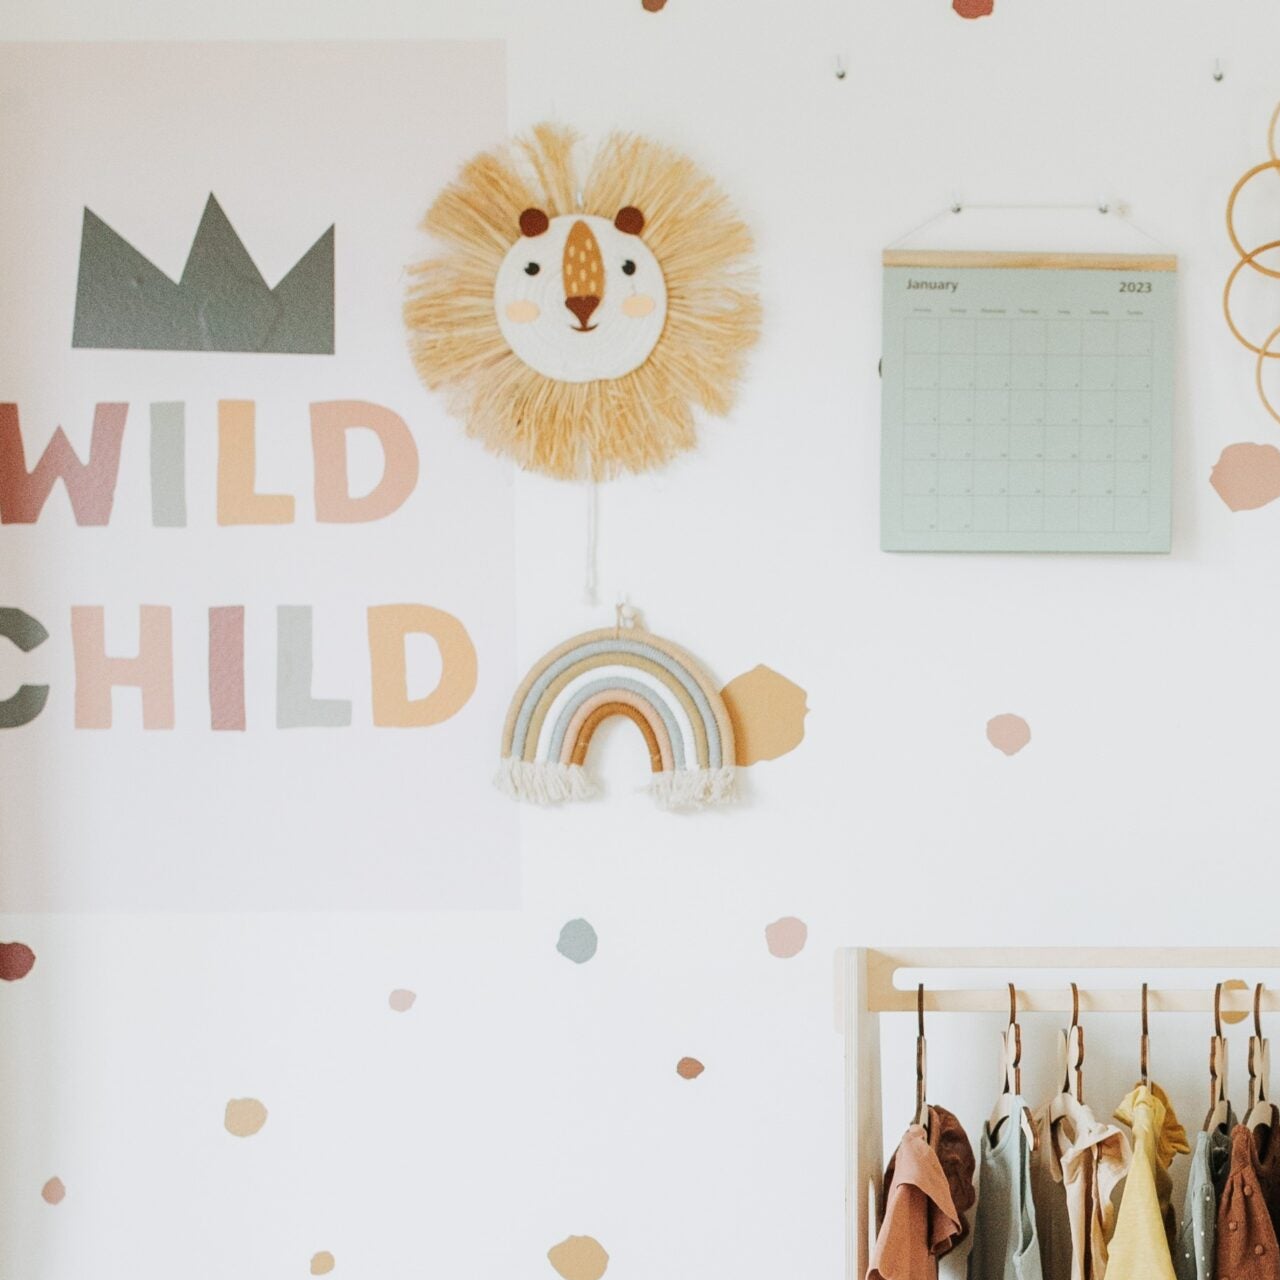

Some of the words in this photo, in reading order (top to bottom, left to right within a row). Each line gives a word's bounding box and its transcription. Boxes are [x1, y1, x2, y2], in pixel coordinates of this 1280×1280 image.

[906, 278, 959, 293] January
[1119, 281, 1153, 293] 2023
[0, 399, 420, 528] WILD
